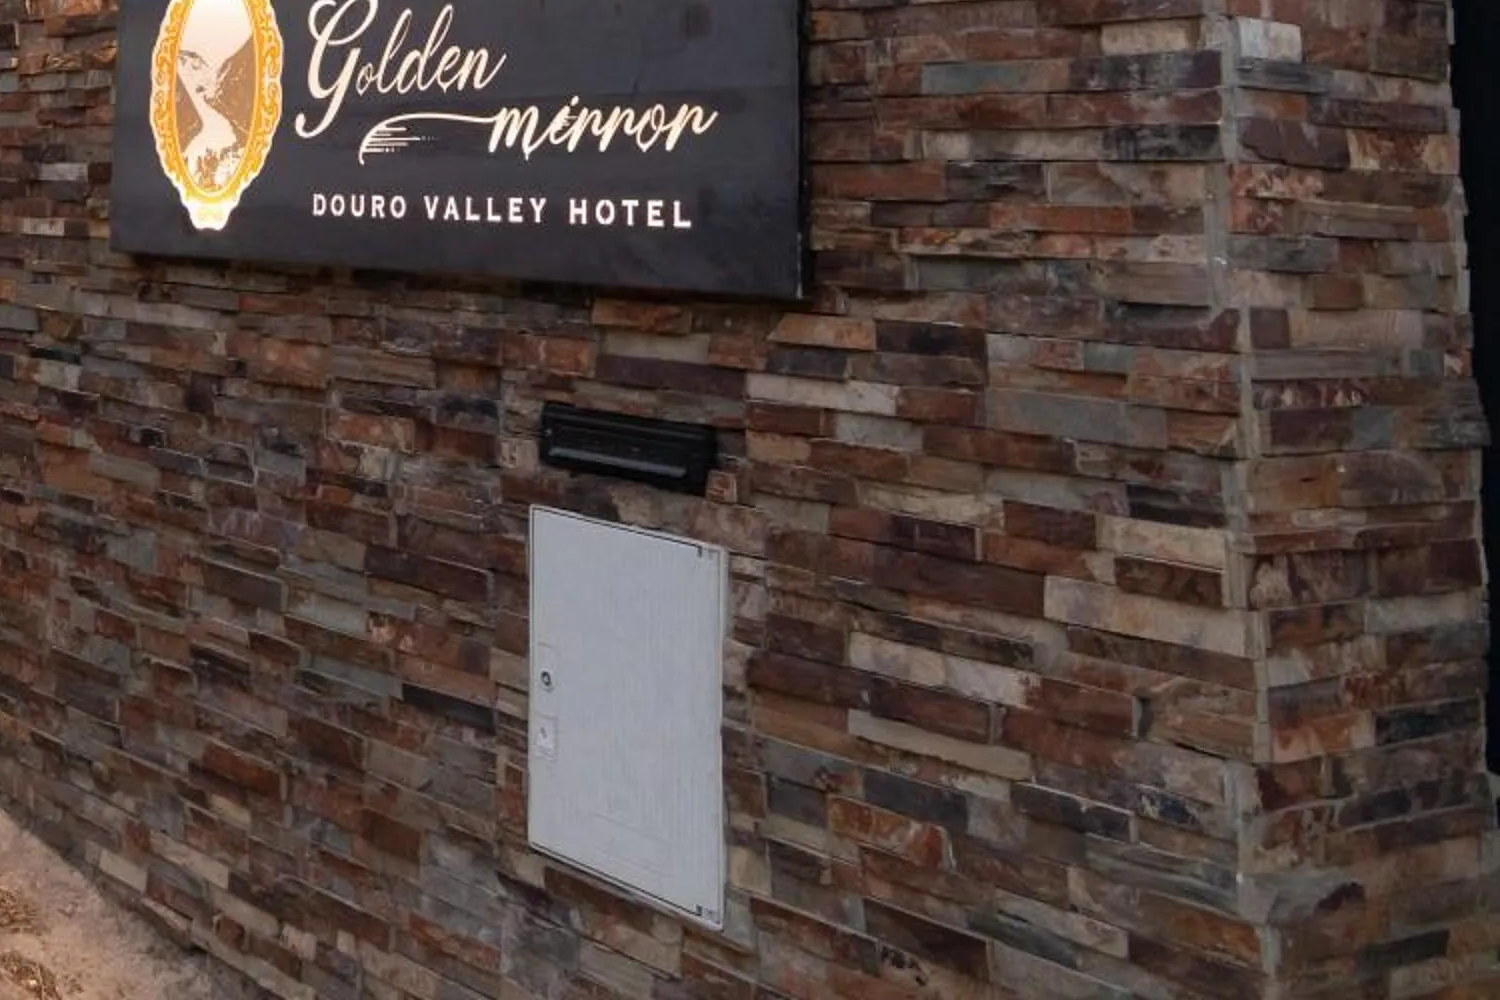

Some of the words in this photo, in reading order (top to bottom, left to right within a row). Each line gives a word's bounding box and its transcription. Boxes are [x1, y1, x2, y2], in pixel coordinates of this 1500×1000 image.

[486, 94, 719, 162] mirror
[311, 192, 408, 220] DOURO
[423, 194, 547, 225] VALLEY
[569, 197, 693, 229] HOTEL
